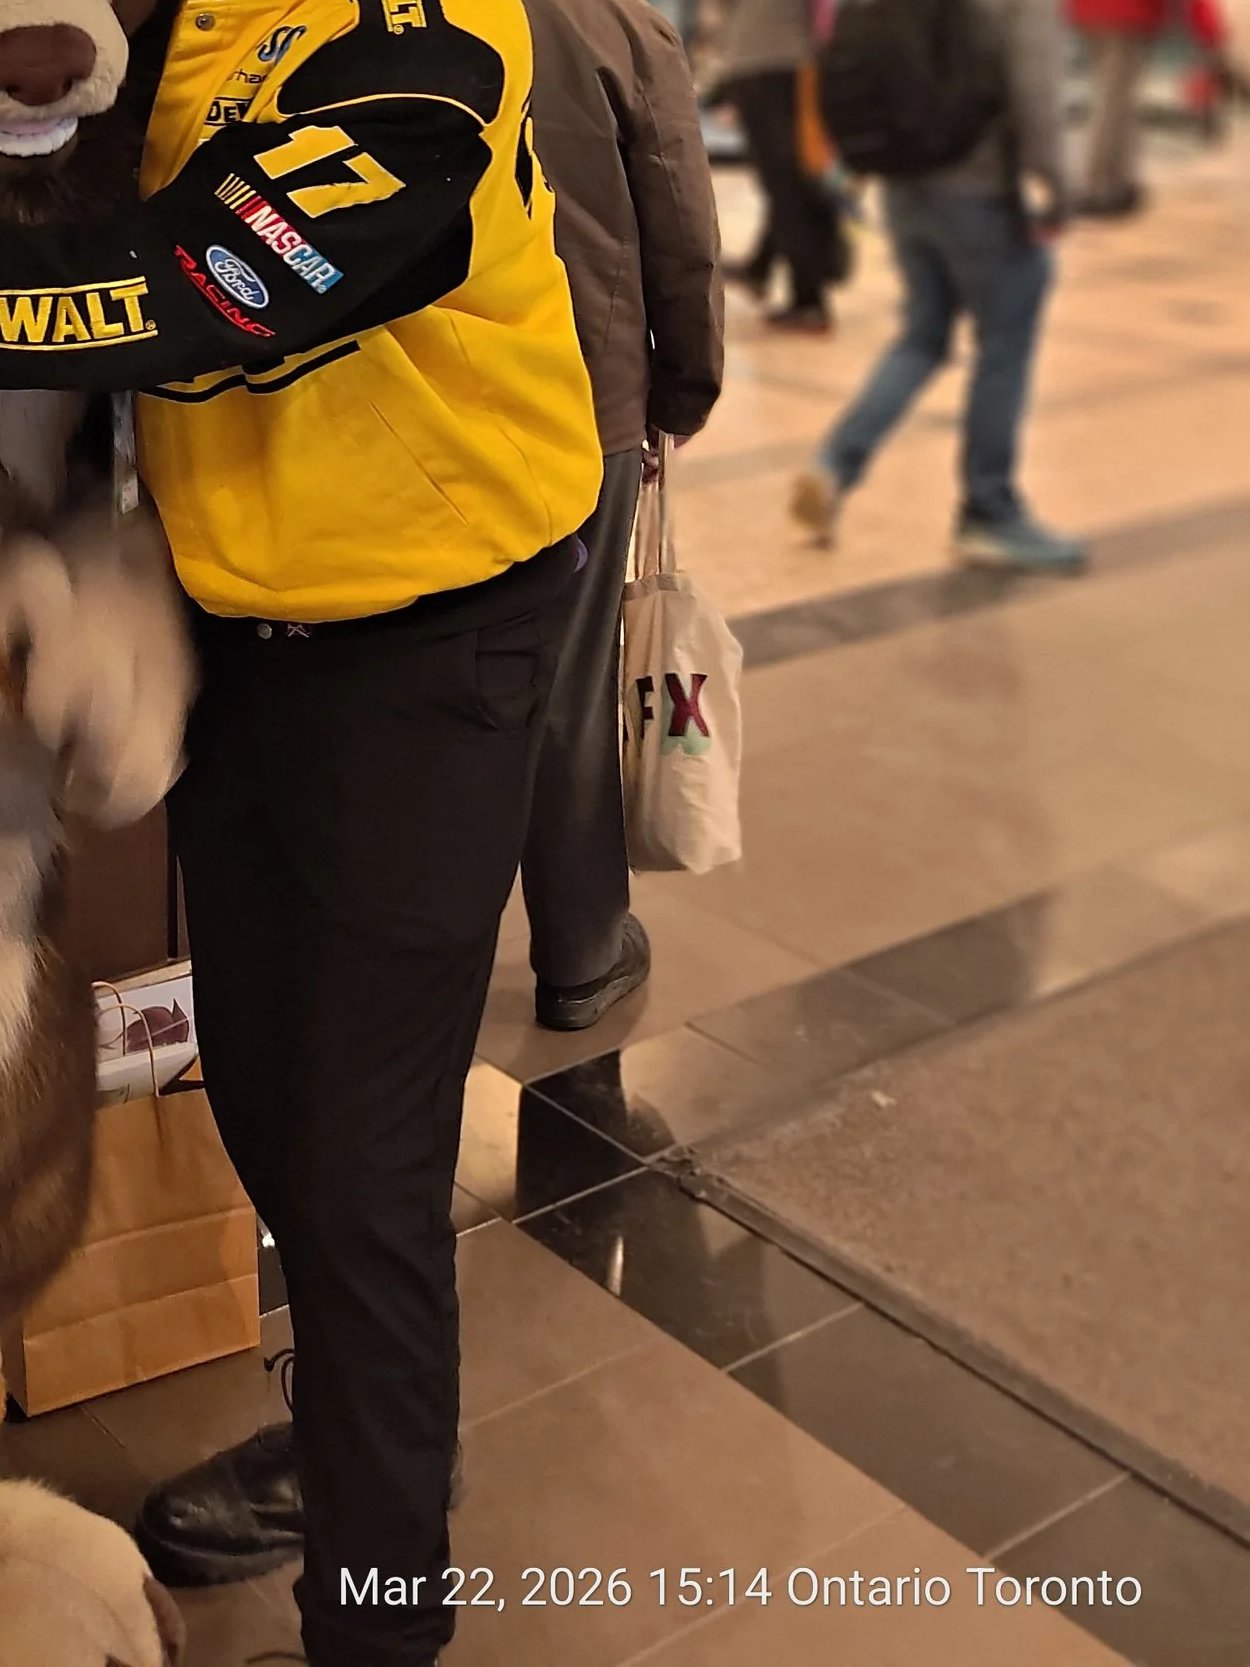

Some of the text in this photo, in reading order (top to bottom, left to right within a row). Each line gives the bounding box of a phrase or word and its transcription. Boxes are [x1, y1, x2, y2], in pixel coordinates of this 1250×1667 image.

[253, 125, 407, 219] 17
[213, 257, 256, 302] Ford
[244, 205, 337, 288] NASCAR
[174, 244, 277, 338] RACING
[624, 672, 711, 741] FX
